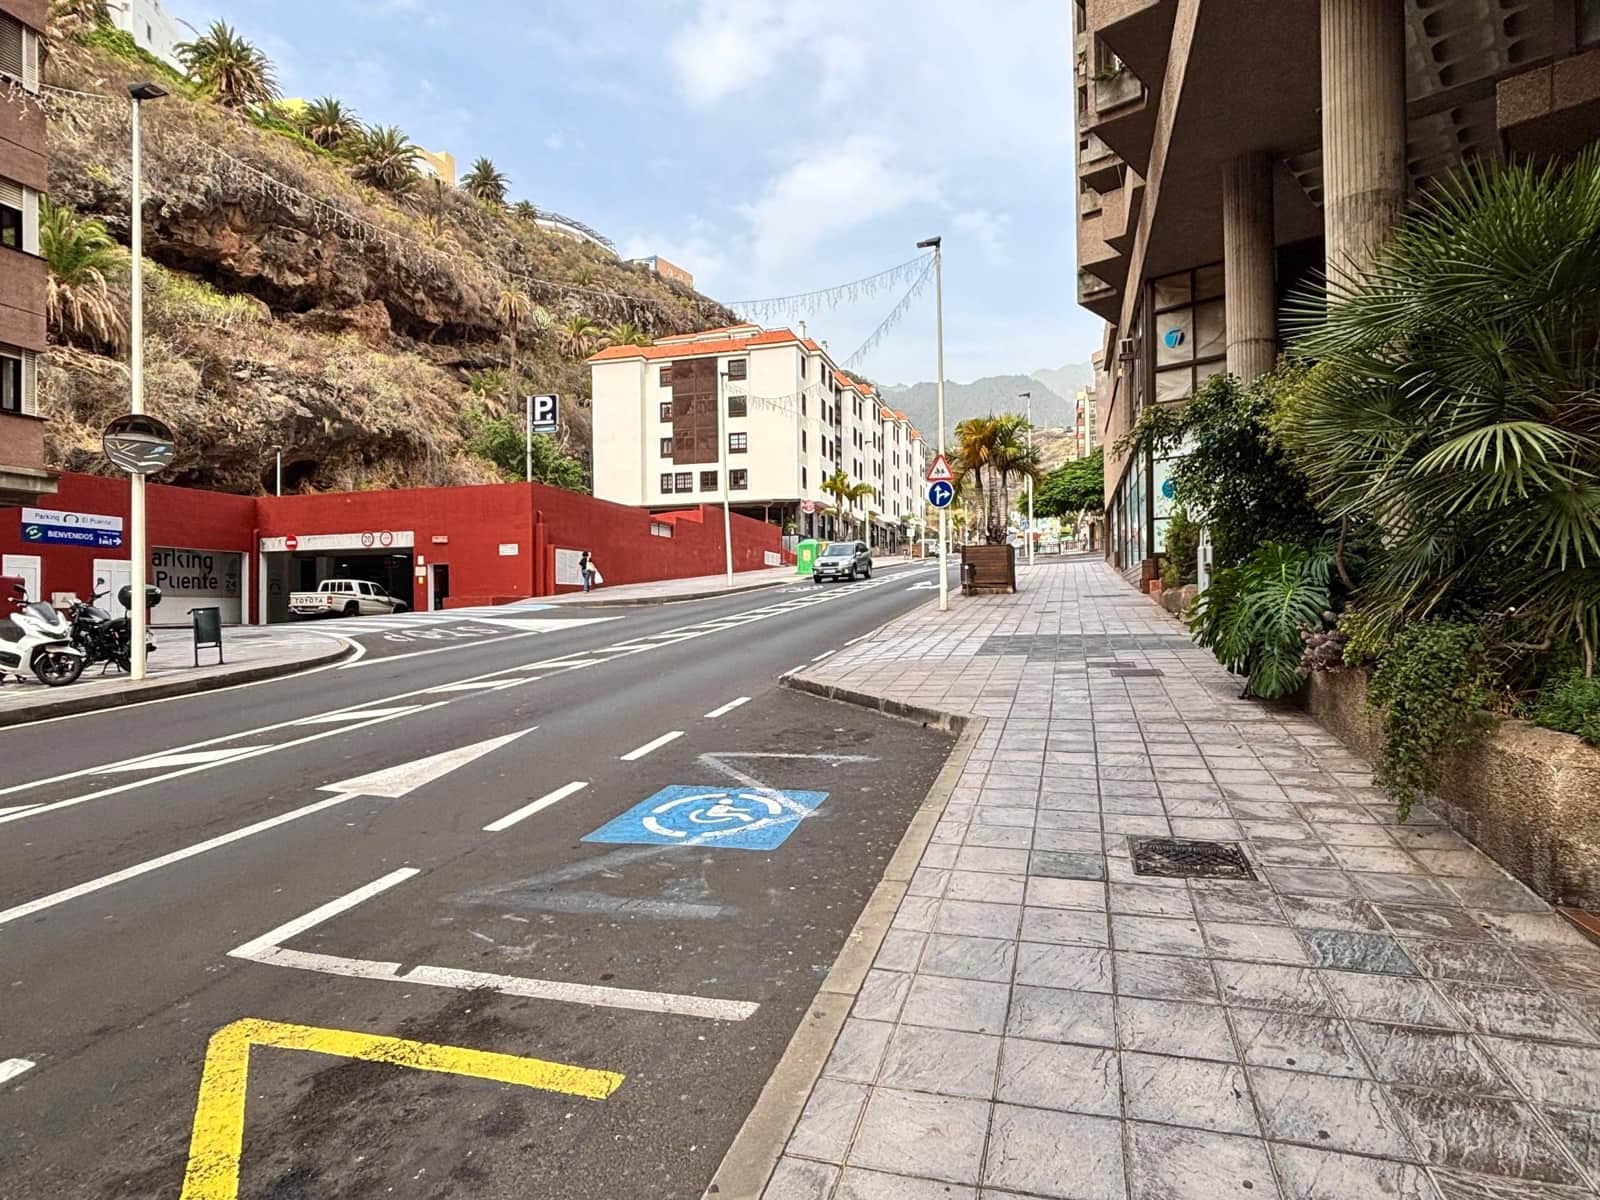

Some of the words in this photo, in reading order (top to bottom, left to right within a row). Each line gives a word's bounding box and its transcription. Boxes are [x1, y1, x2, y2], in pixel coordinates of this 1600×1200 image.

[534, 396, 553, 420] P
[35, 512, 60, 521] Parking
[90, 518, 112, 526] Puente
[47, 530, 94, 541] BIENVENIDOS
[151, 549, 213, 574] arking
[156, 570, 218, 590] Puente
